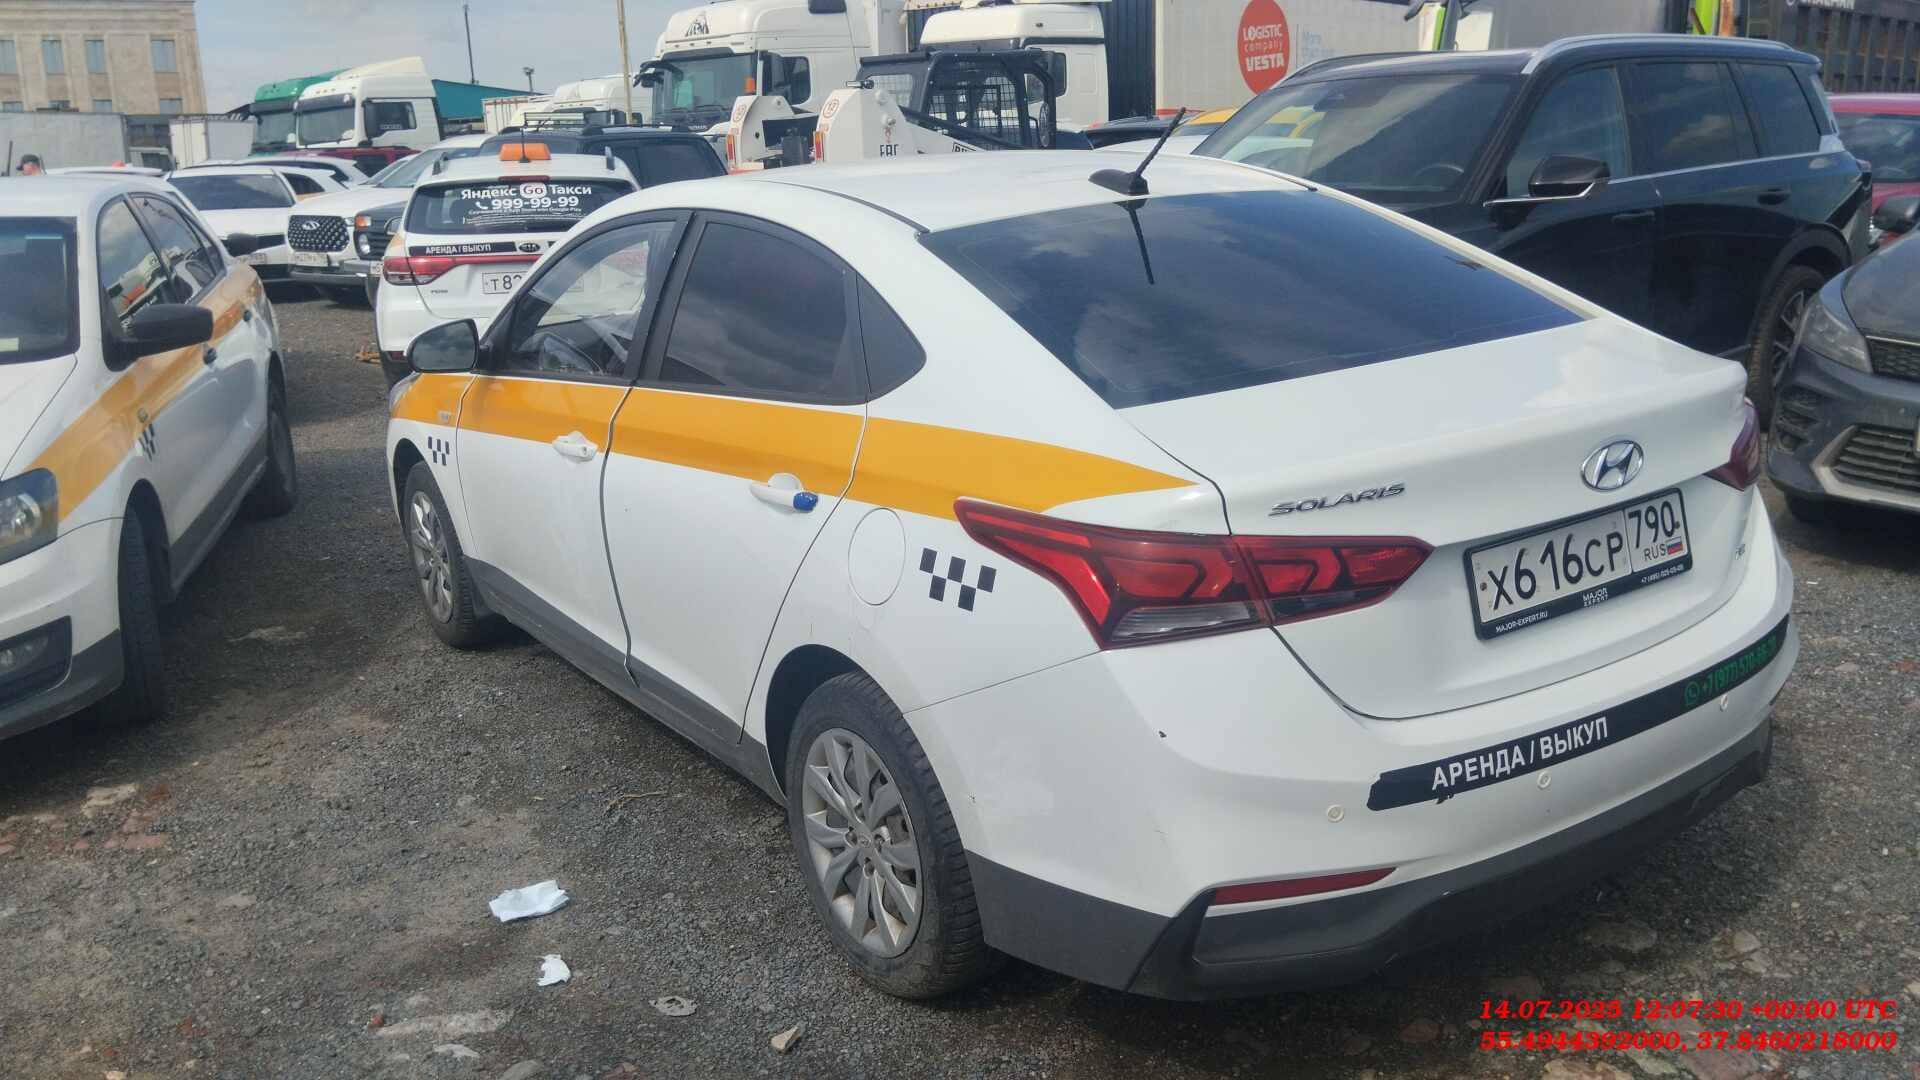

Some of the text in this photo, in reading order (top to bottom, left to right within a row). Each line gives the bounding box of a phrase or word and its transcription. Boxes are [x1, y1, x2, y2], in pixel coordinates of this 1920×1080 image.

[1243, 24, 1283, 40] LOGISTIC
[1245, 53, 1285, 72] VESTA
[461, 185, 592, 200] Яндекс Go Такси
[491, 196, 579, 210] 999-99-99
[426, 246, 457, 255] АРЕНДА
[462, 244, 492, 253] ВЫКУП
[1268, 483, 1405, 516] SOLARIS
[1628, 501, 1676, 549] 790
[1643, 542, 1667, 562] RUS
[1582, 587, 1608, 602] MAJOR
[1495, 610, 1548, 633] MAJOR-EXPERT.RU
[1431, 744, 1526, 790] АРЕНДА
[1539, 716, 1608, 760] ВЫКУП
